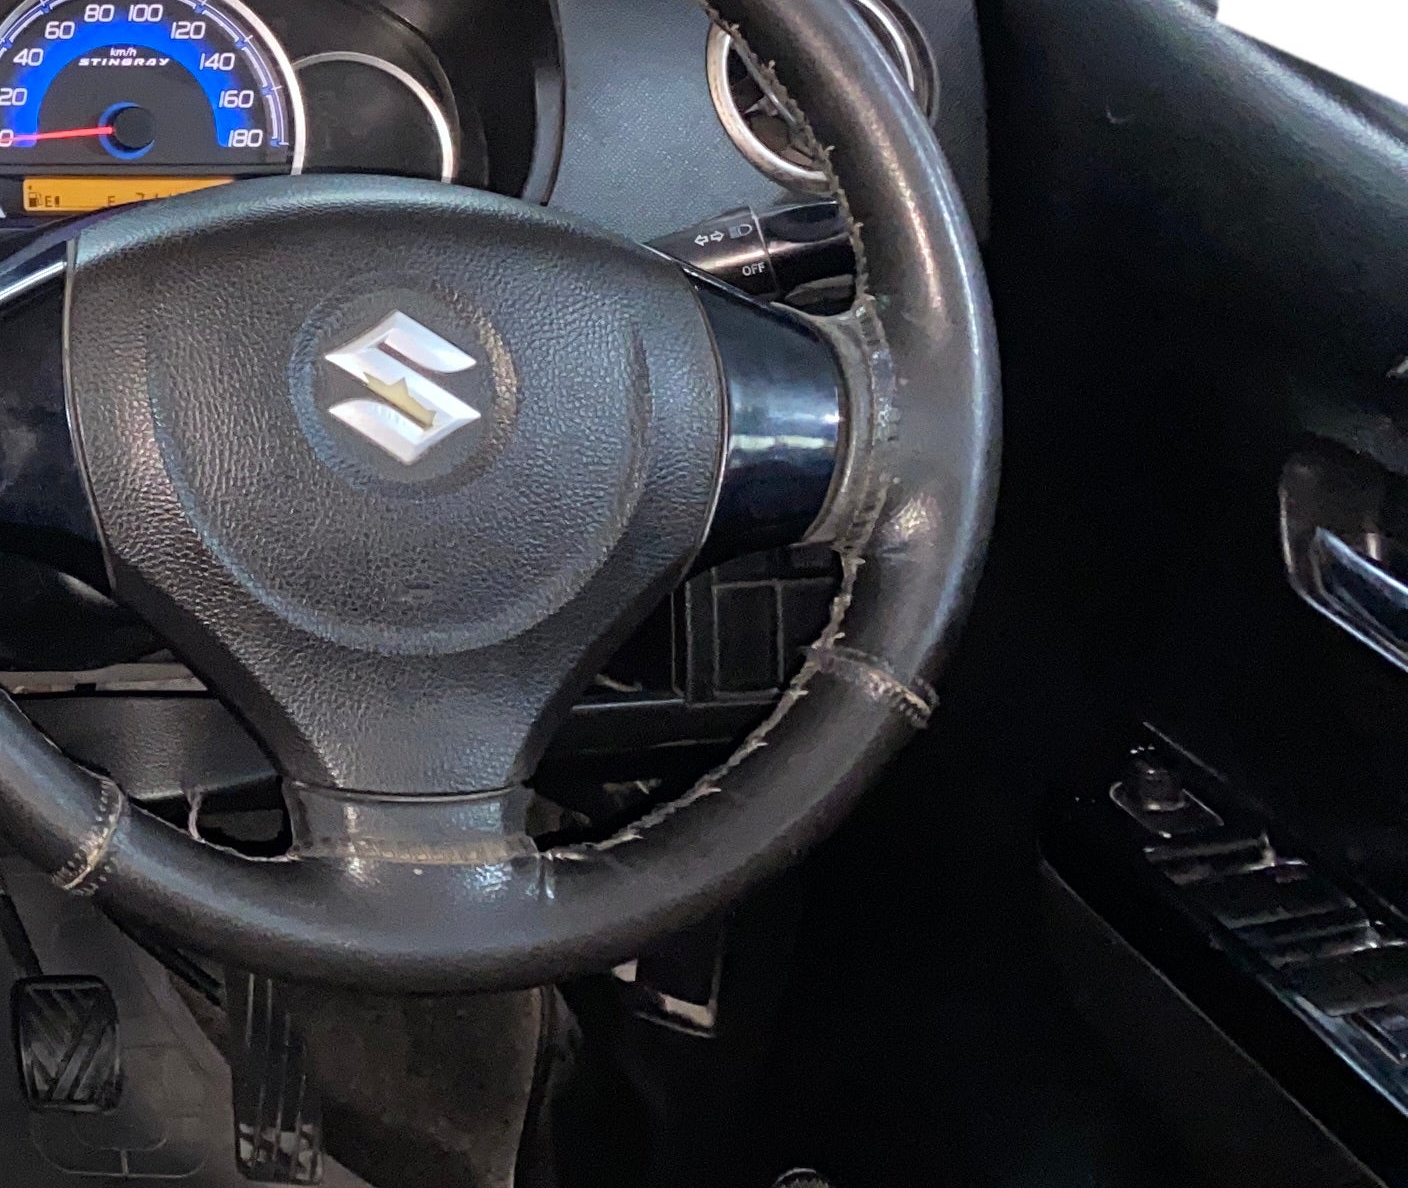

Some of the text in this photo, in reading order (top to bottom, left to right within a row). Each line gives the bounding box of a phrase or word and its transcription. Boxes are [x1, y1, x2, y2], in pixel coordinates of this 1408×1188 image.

[84, 4, 115, 22] 80
[127, 4, 164, 22] 100
[44, 21, 76, 39] 60
[170, 21, 206, 40] 120
[13, 48, 44, 66] 40
[110, 47, 137, 57] km/h
[78, 58, 170, 67] STINGRAY
[199, 52, 236, 71] 140
[218, 90, 255, 108] 160
[227, 129, 264, 147] 180
[741, 262, 766, 277] OFF
